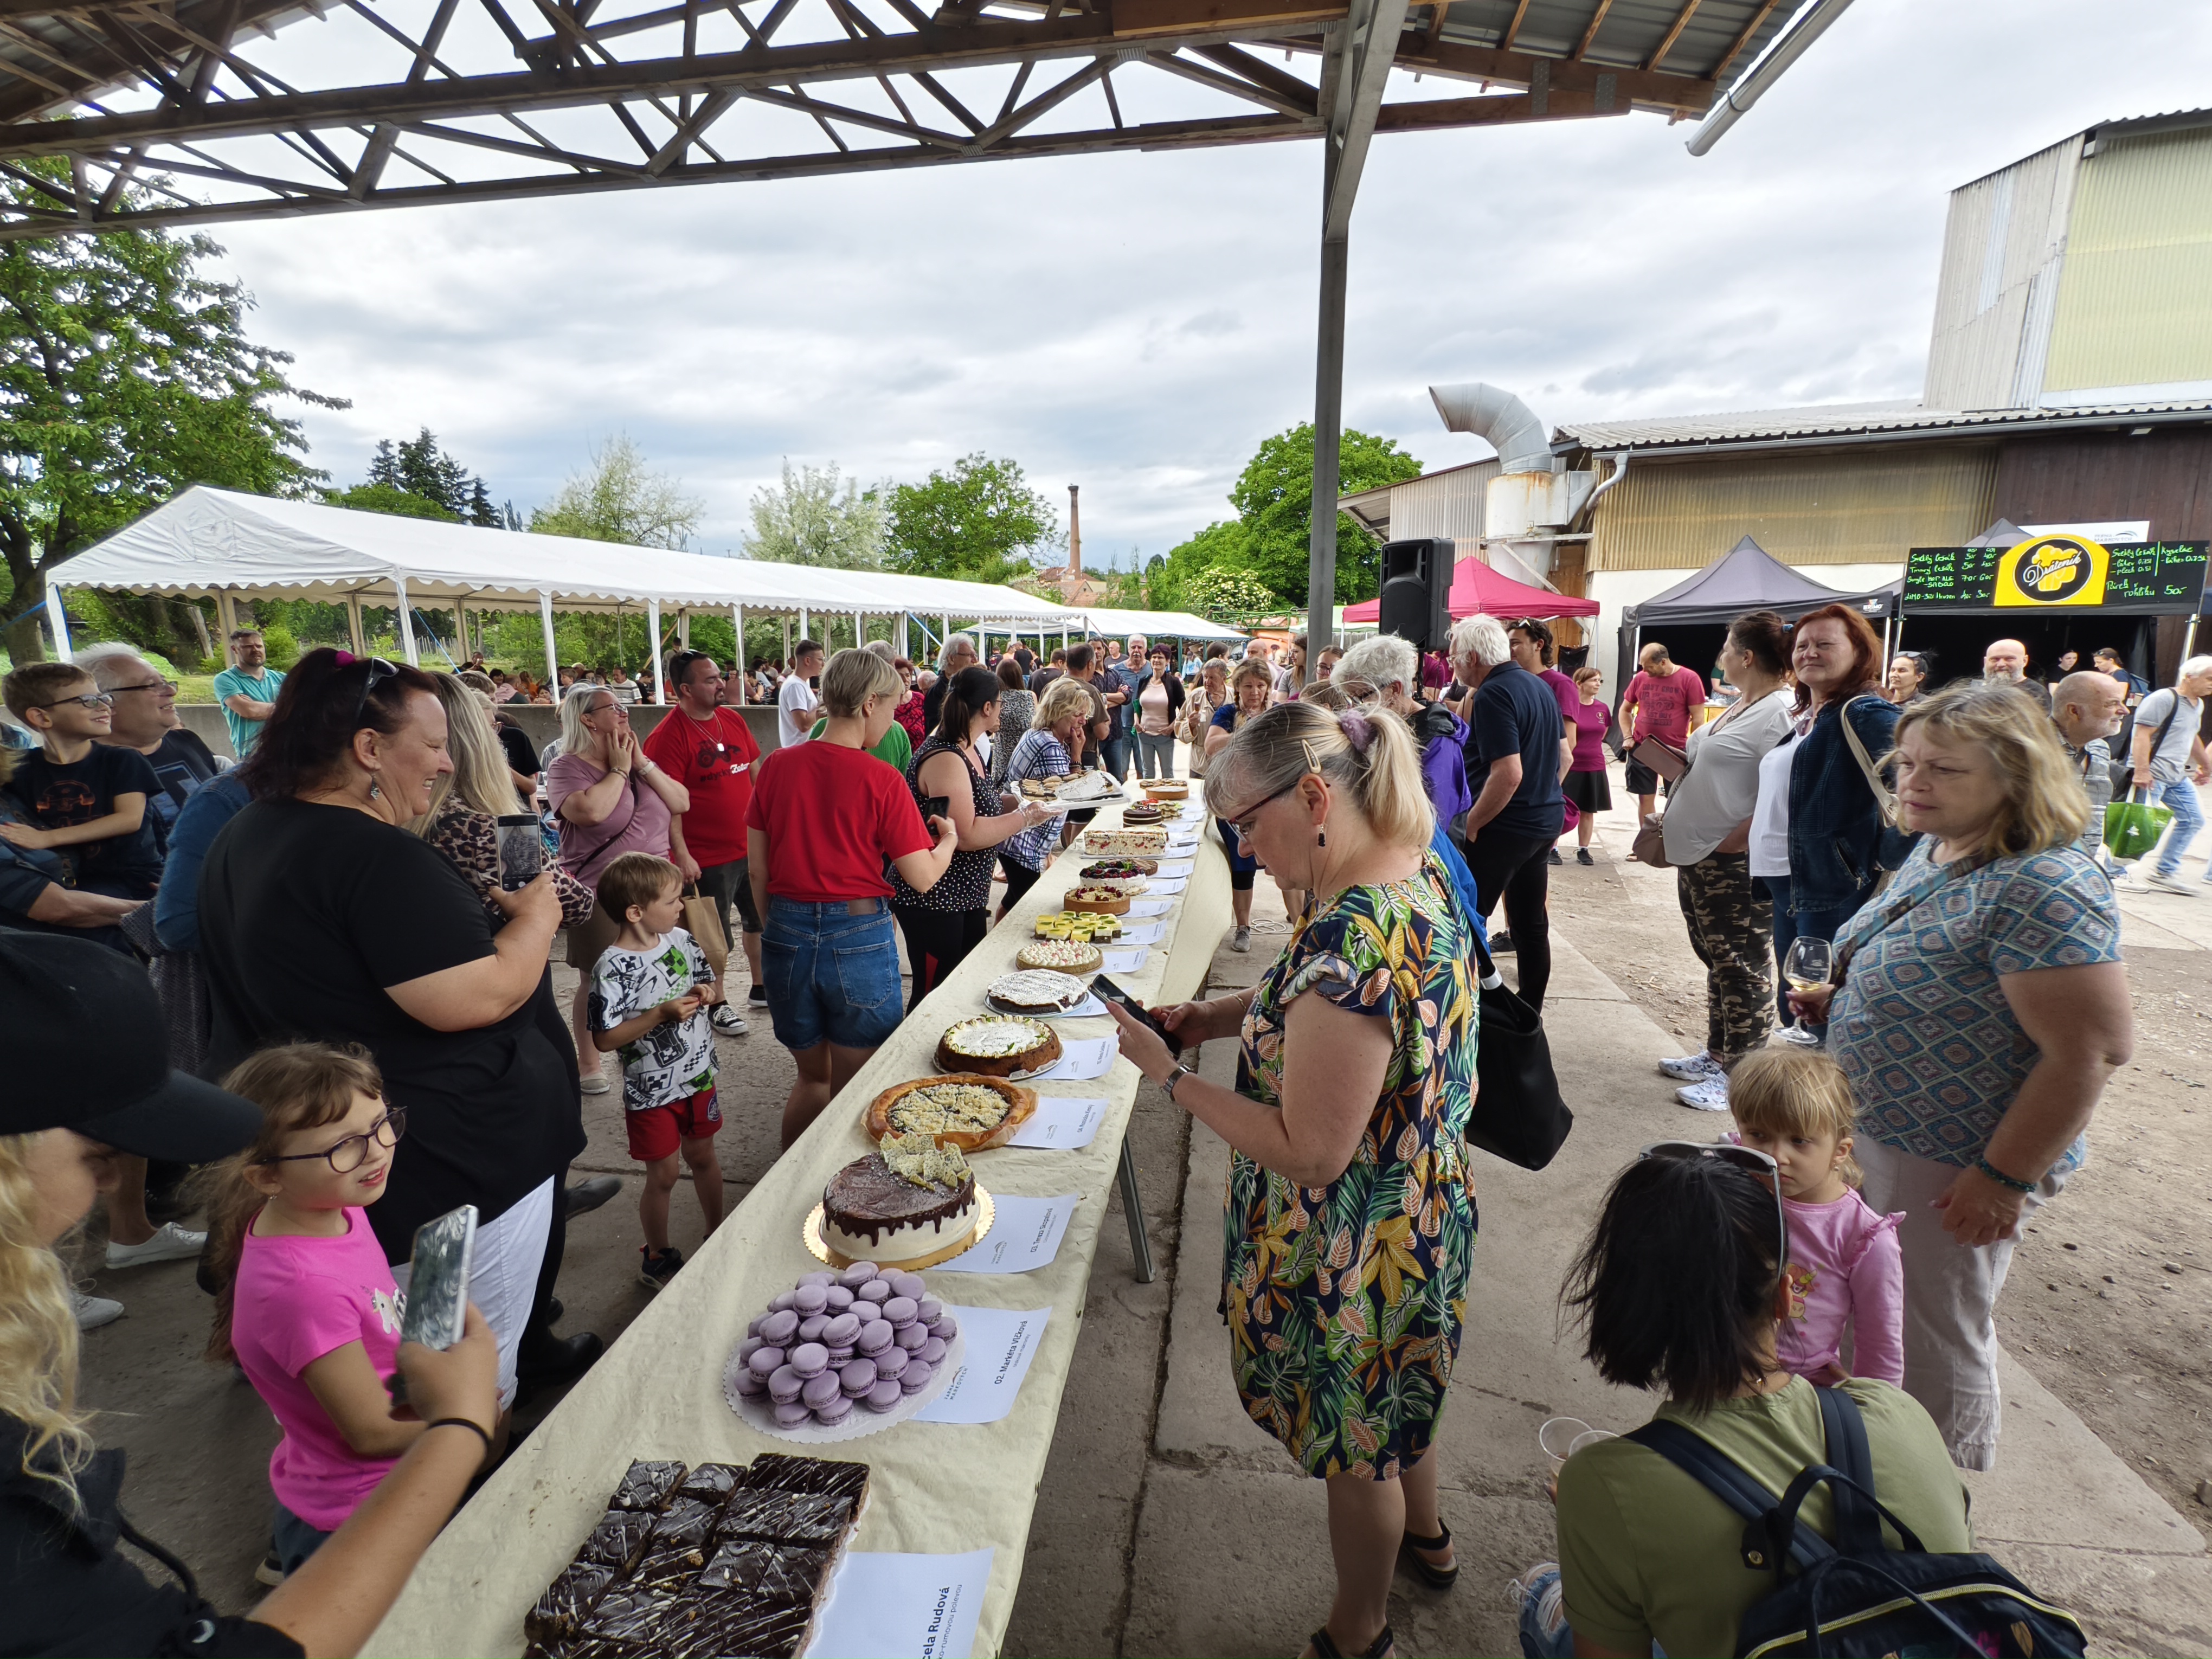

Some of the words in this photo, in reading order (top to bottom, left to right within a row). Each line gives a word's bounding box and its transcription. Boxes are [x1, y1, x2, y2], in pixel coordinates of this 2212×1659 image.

[999, 1345, 1017, 1372] Markéta
[1011, 1320, 1028, 1345] Vlčková
[928, 1586, 950, 1632] Rudová
[950, 1584, 962, 1613] polevou
